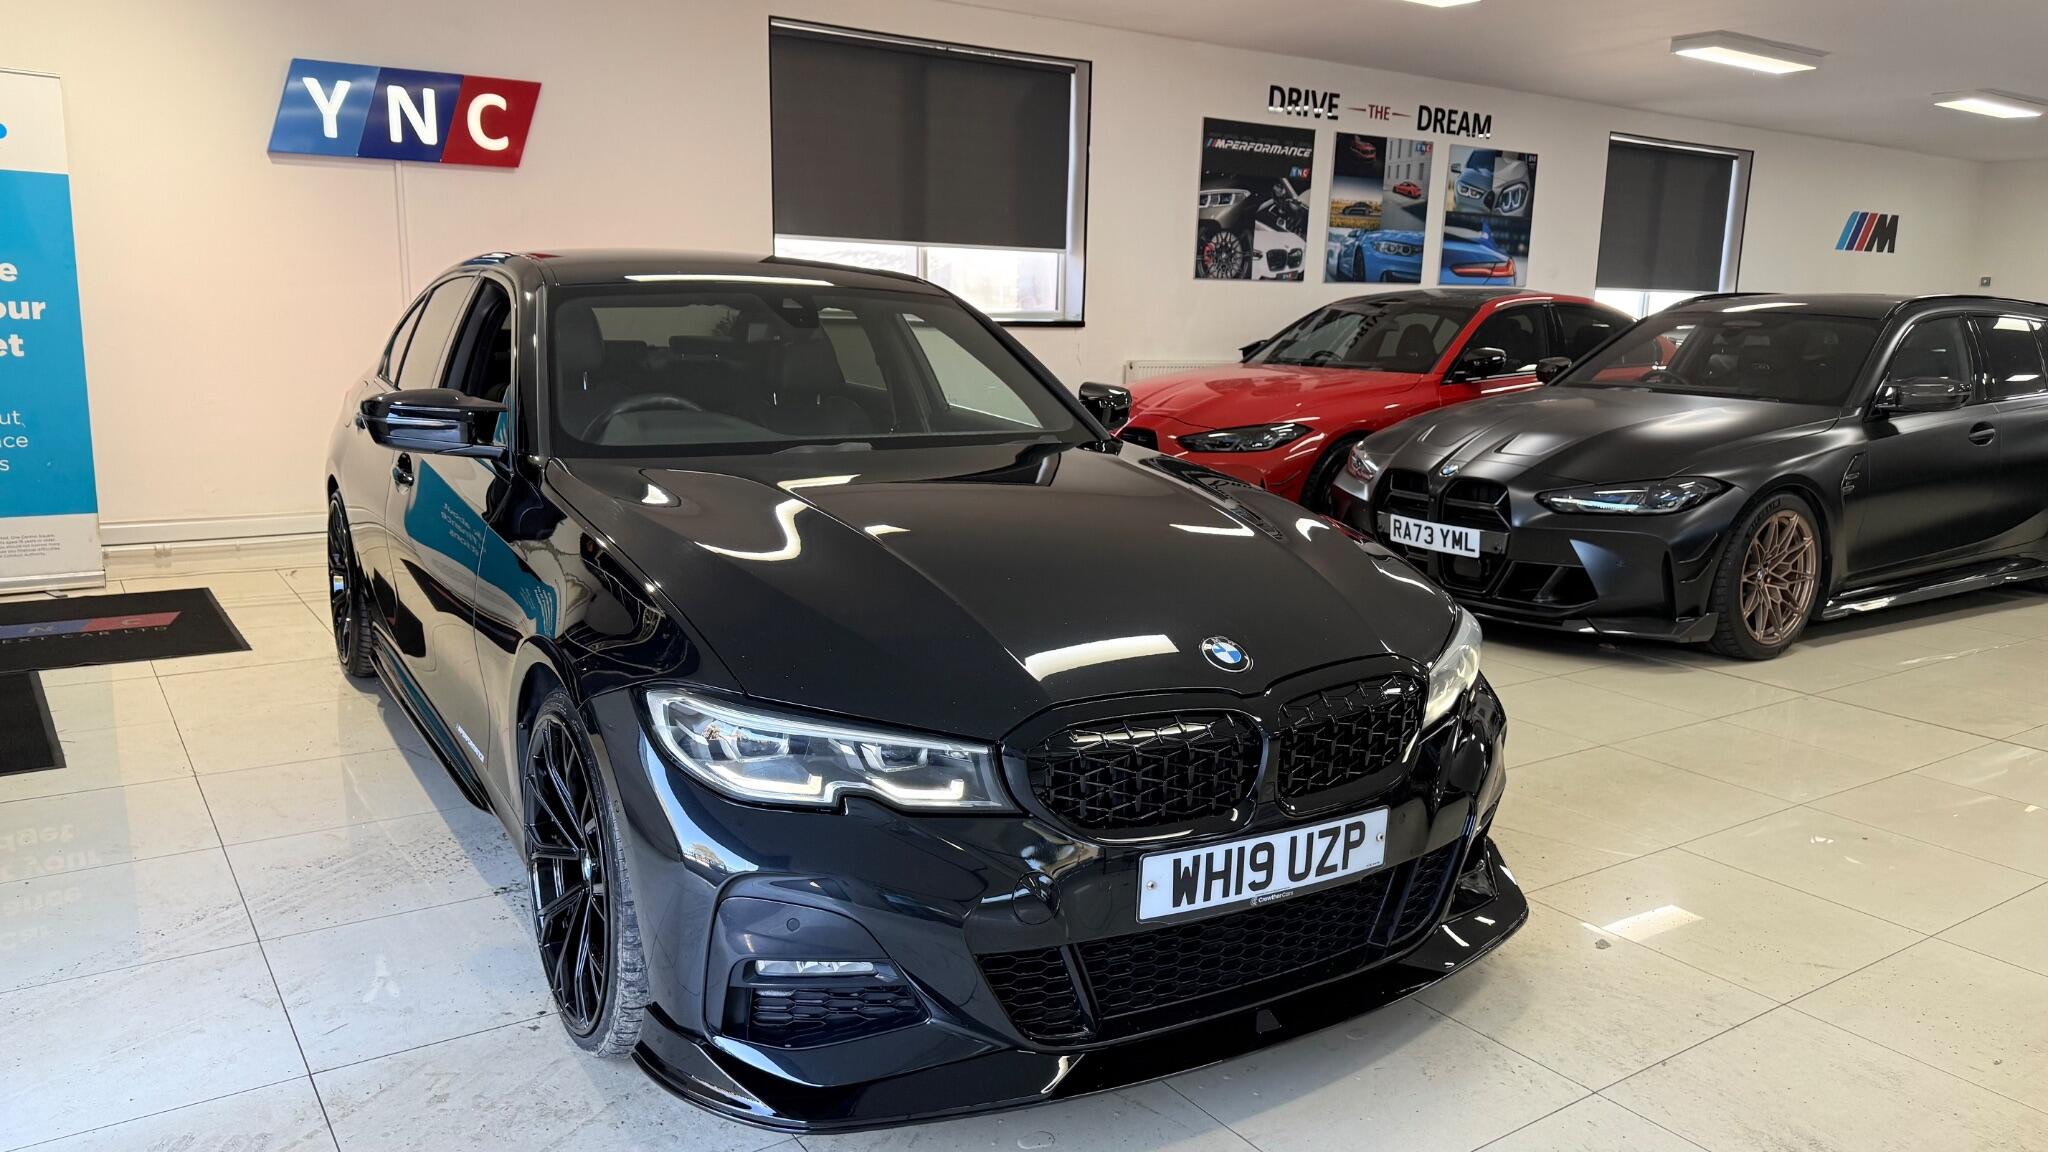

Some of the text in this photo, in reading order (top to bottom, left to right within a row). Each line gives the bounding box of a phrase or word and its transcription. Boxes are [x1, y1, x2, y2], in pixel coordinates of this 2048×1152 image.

[303, 77, 509, 151] YNC
[1268, 85, 1492, 140] DRIVE THE DREAM
[1393, 519, 1475, 553] RA73 YML
[1172, 820, 1366, 908] WH19 UZP
